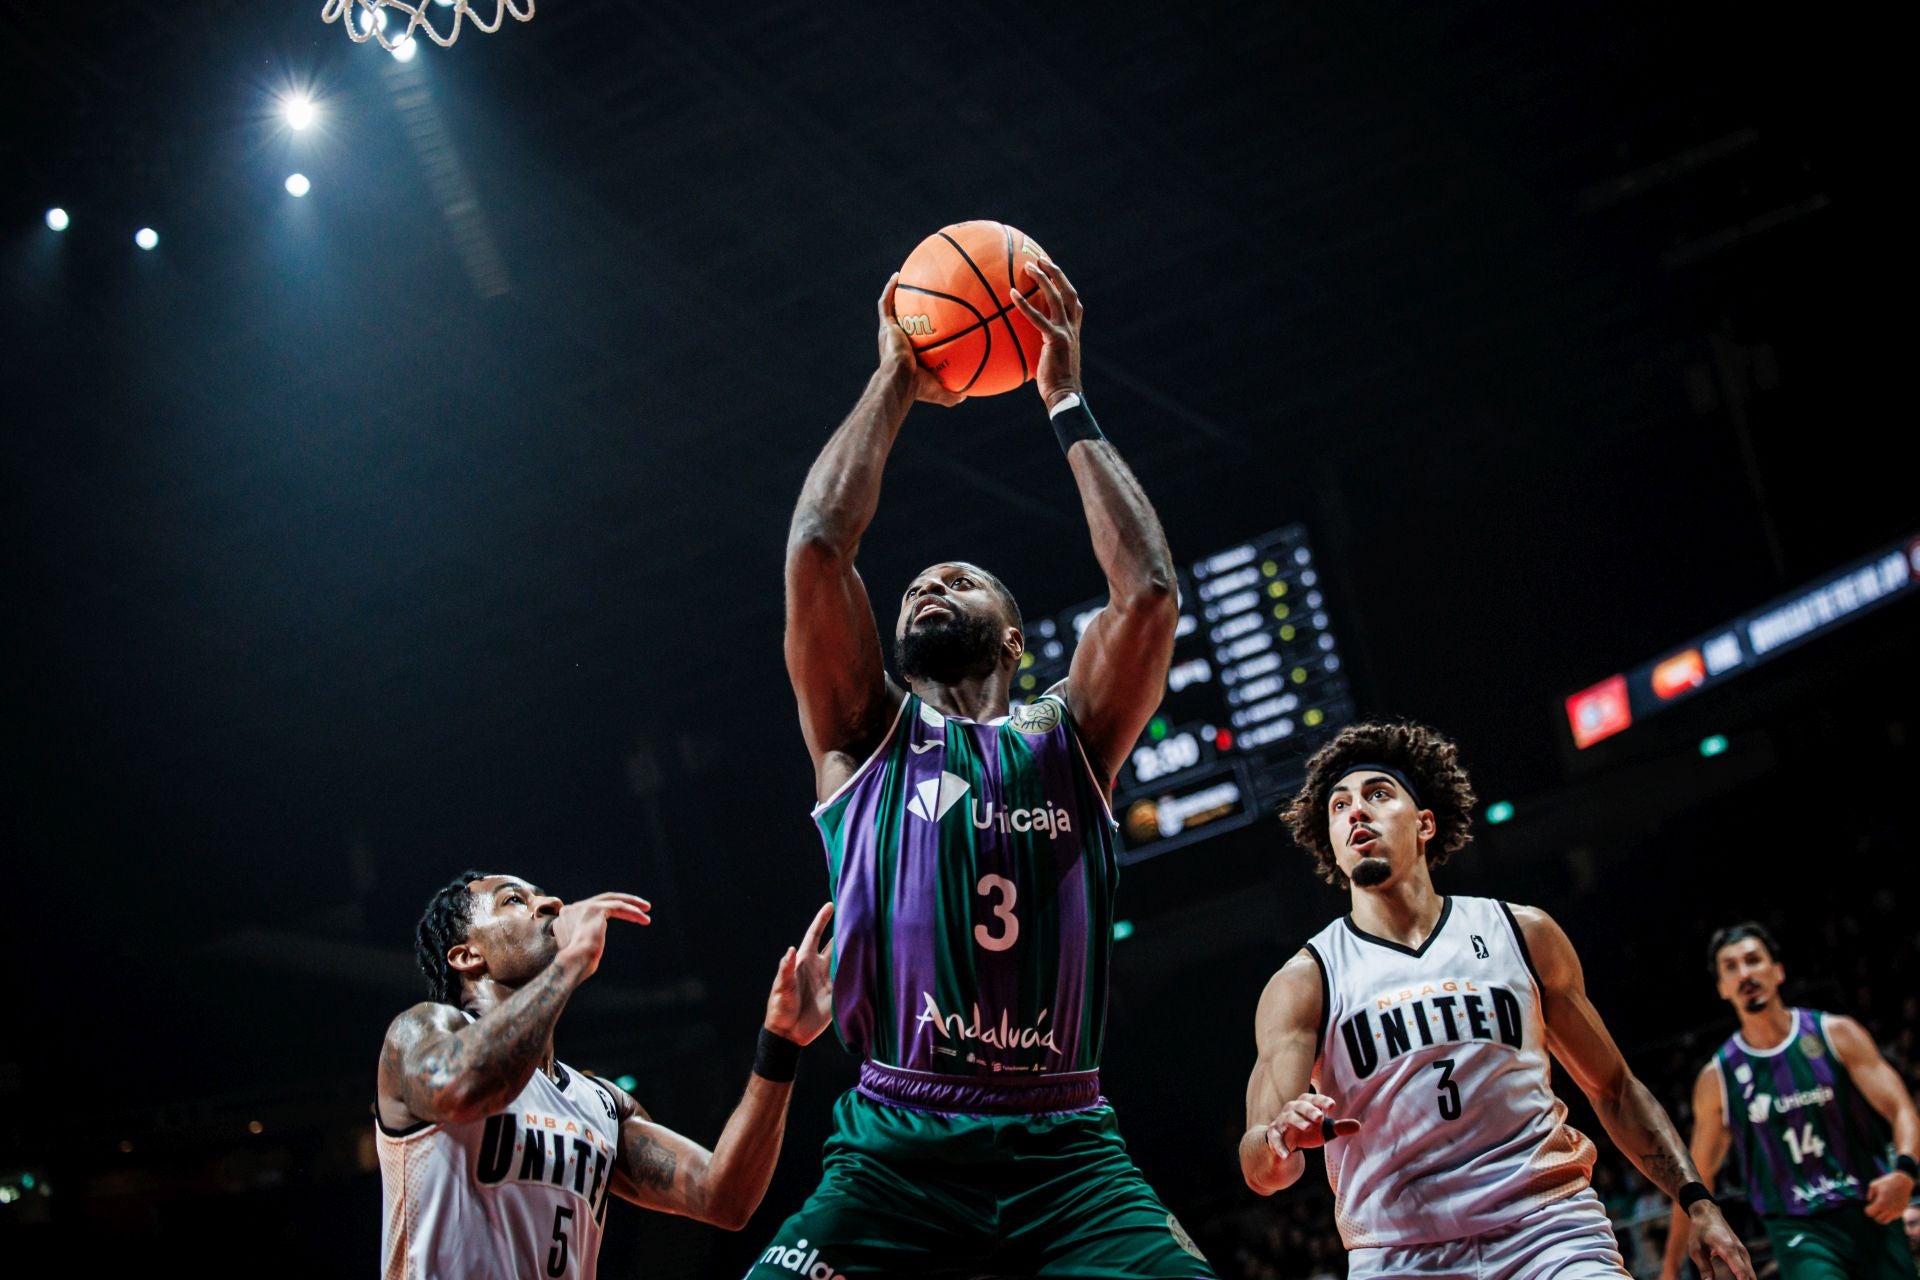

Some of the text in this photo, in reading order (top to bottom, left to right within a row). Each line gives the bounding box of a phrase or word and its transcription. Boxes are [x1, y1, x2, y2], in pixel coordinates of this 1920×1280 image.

[972, 798, 1072, 840] Unicaja
[974, 874, 1019, 952] 3
[915, 991, 1063, 1055] Andalucía
[1341, 986, 1524, 1080] UNITED
[1432, 1059, 1463, 1121] 3
[1782, 1122, 1826, 1165] 14
[546, 1205, 574, 1278] 5
[759, 1238, 846, 1280] mála
